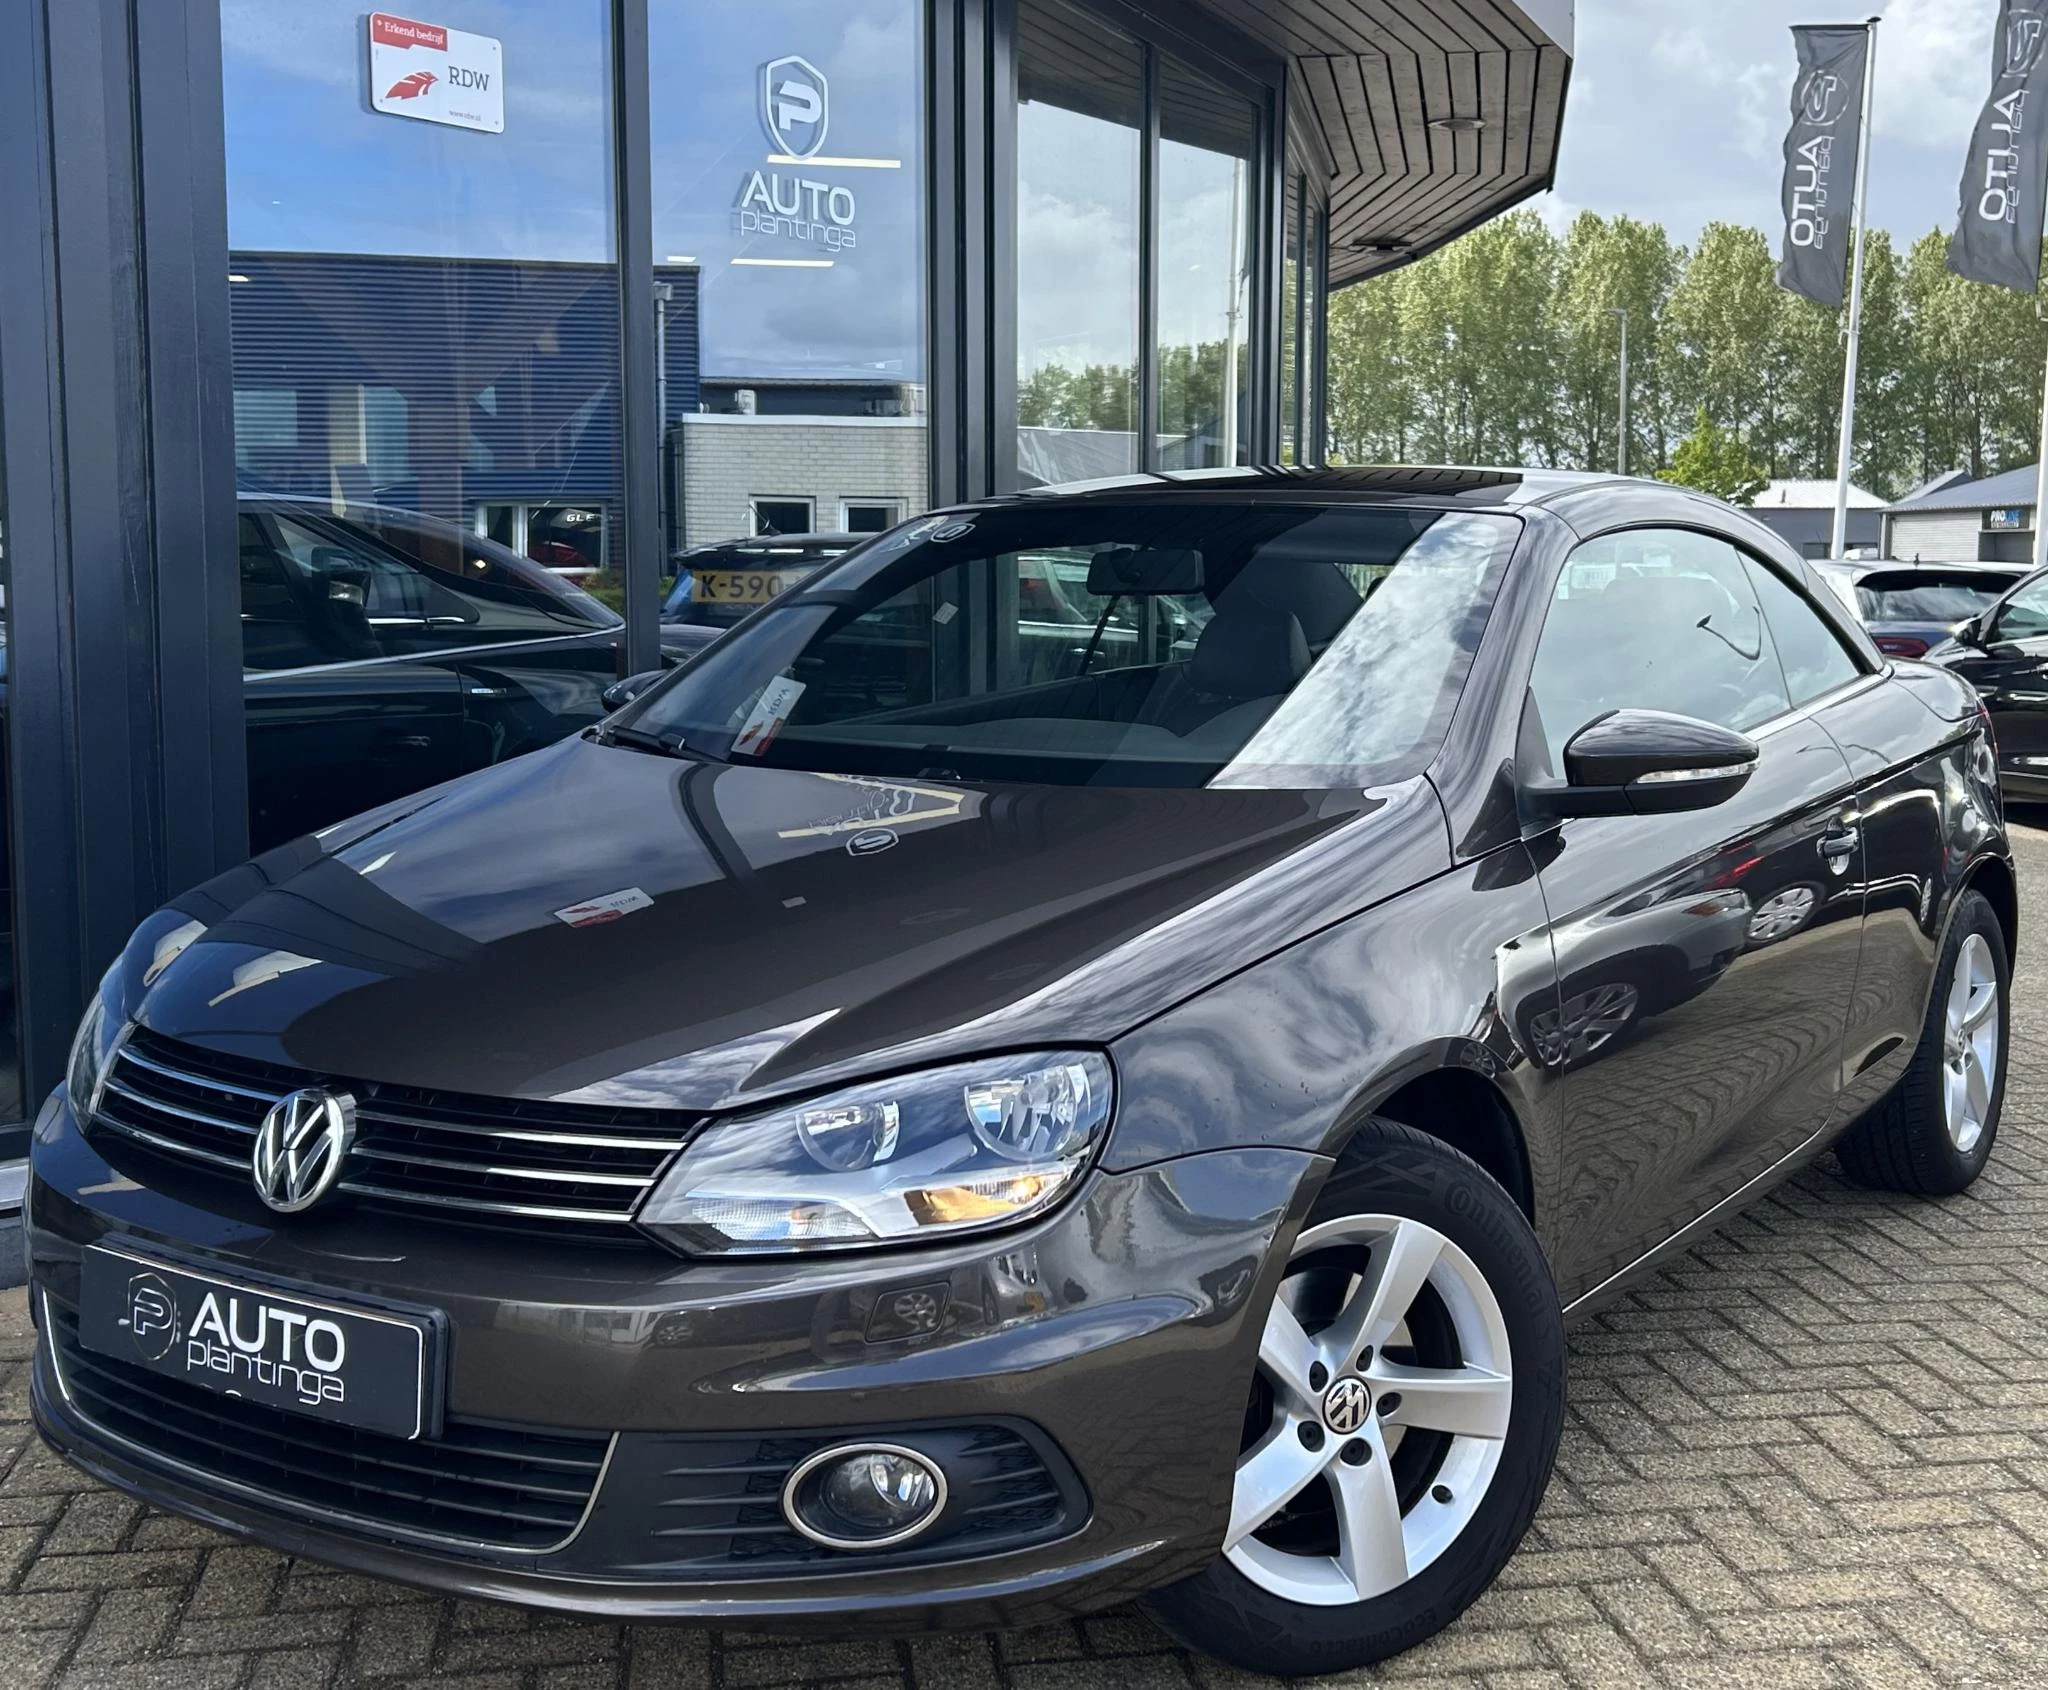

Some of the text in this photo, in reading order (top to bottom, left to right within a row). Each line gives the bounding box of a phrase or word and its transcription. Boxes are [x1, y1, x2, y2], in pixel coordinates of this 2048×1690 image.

[384, 21, 443, 45] Erkend bedrijf
[448, 66, 490, 92] RDW
[778, 79, 823, 131] P
[742, 170, 856, 226] AUTO
[740, 209, 857, 253] plantinga
[188, 1291, 346, 1373] AUTO
[186, 1339, 346, 1406] plantinga
